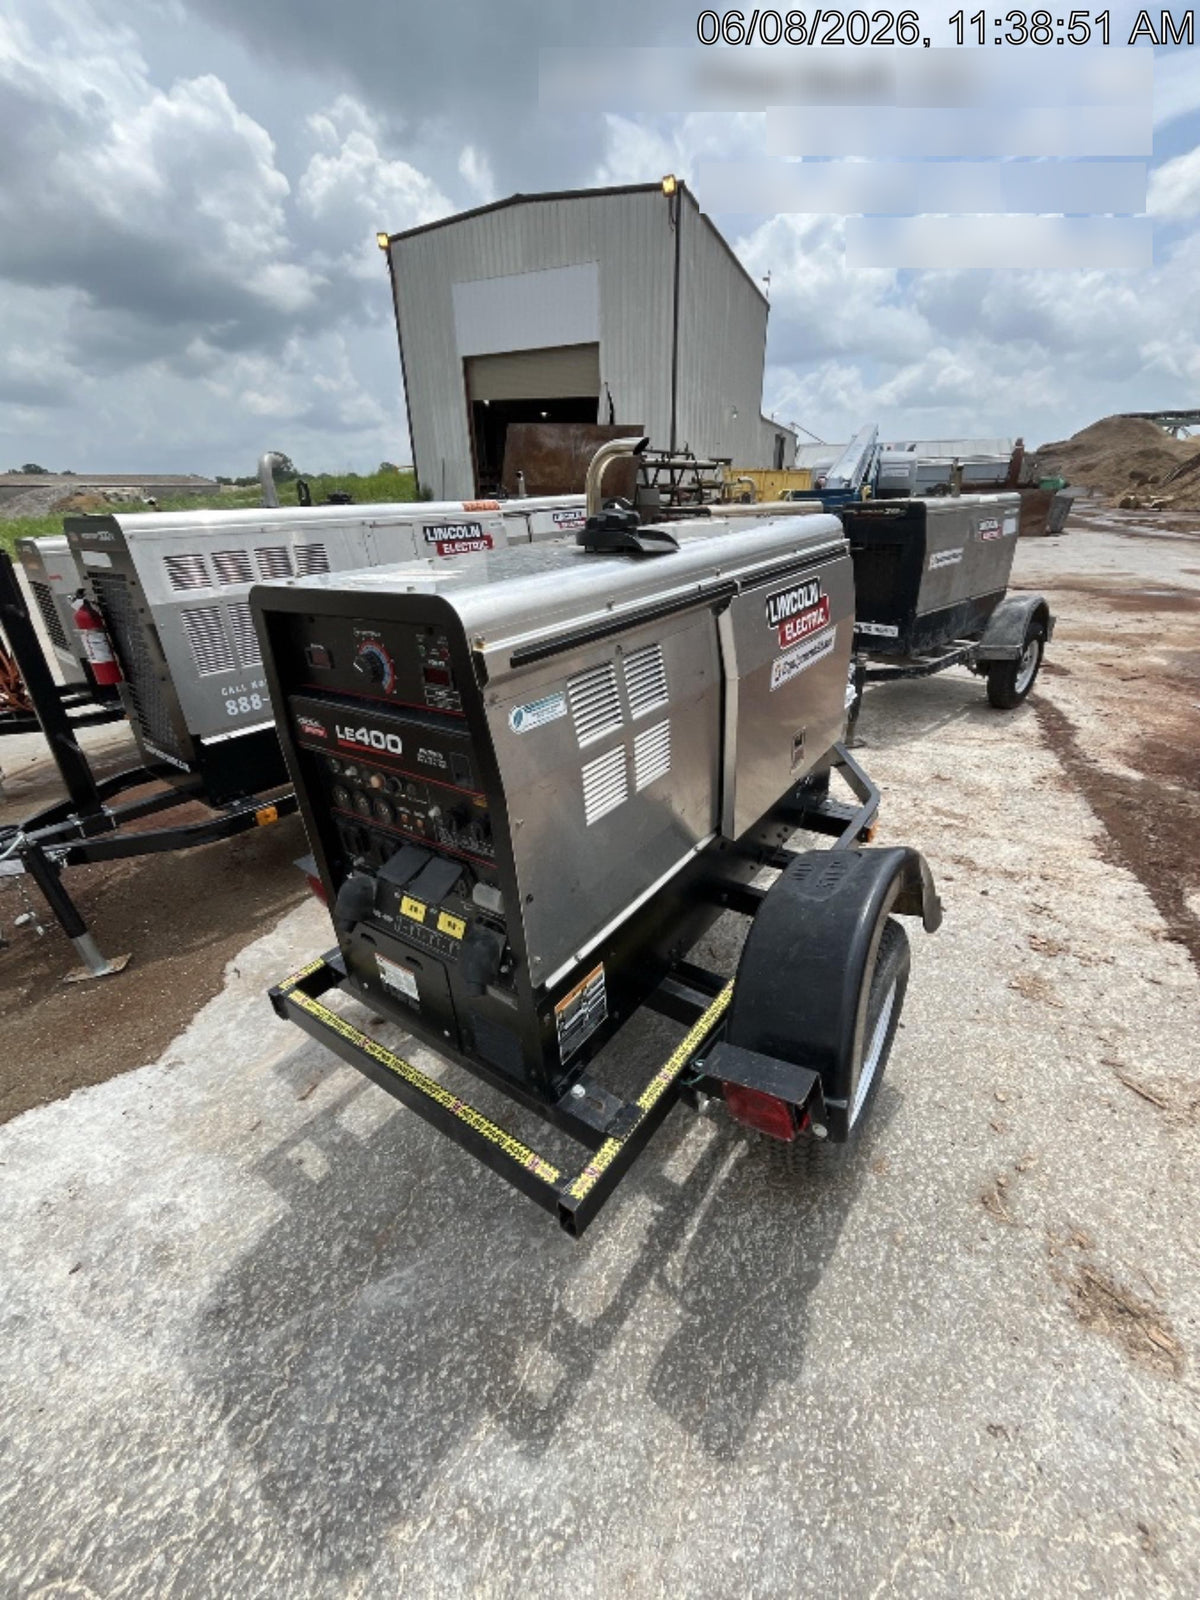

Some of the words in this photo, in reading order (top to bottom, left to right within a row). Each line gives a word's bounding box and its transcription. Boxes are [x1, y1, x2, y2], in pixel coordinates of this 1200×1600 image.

[425, 525, 481, 541] LINCOLN
[442, 539, 489, 554] ELECTRIC
[769, 582, 819, 623] LINCOLN
[785, 607, 826, 641] ELECTRIC
[336, 724, 403, 754] LE400
